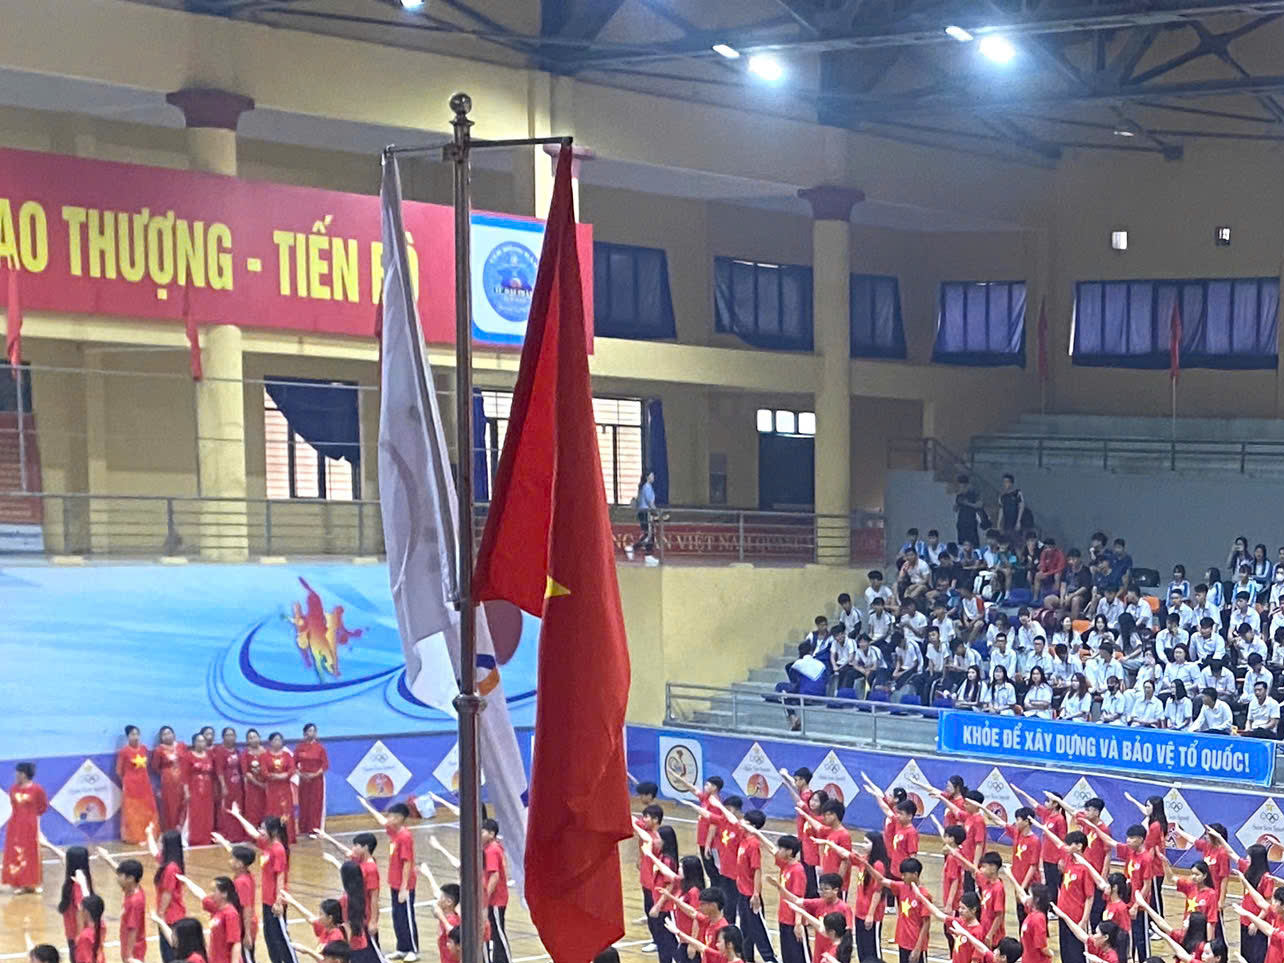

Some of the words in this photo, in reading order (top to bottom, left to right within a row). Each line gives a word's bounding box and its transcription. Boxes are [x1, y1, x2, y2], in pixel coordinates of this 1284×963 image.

[62, 205, 233, 300] THƯỢNG
[273, 214, 359, 304] TIẾN
[963, 719, 999, 748] KHỎE
[1002, 722, 1022, 750] ĐỂ
[1024, 726, 1052, 752] XÂY
[1056, 735, 1096, 760] DỰNG
[1099, 734, 1118, 759] VÀ
[1122, 735, 1152, 763] BẢO
[1157, 739, 1175, 769] VỆ
[1179, 740, 1198, 768] TỔ
[1201, 743, 1250, 773] QUỐC!
